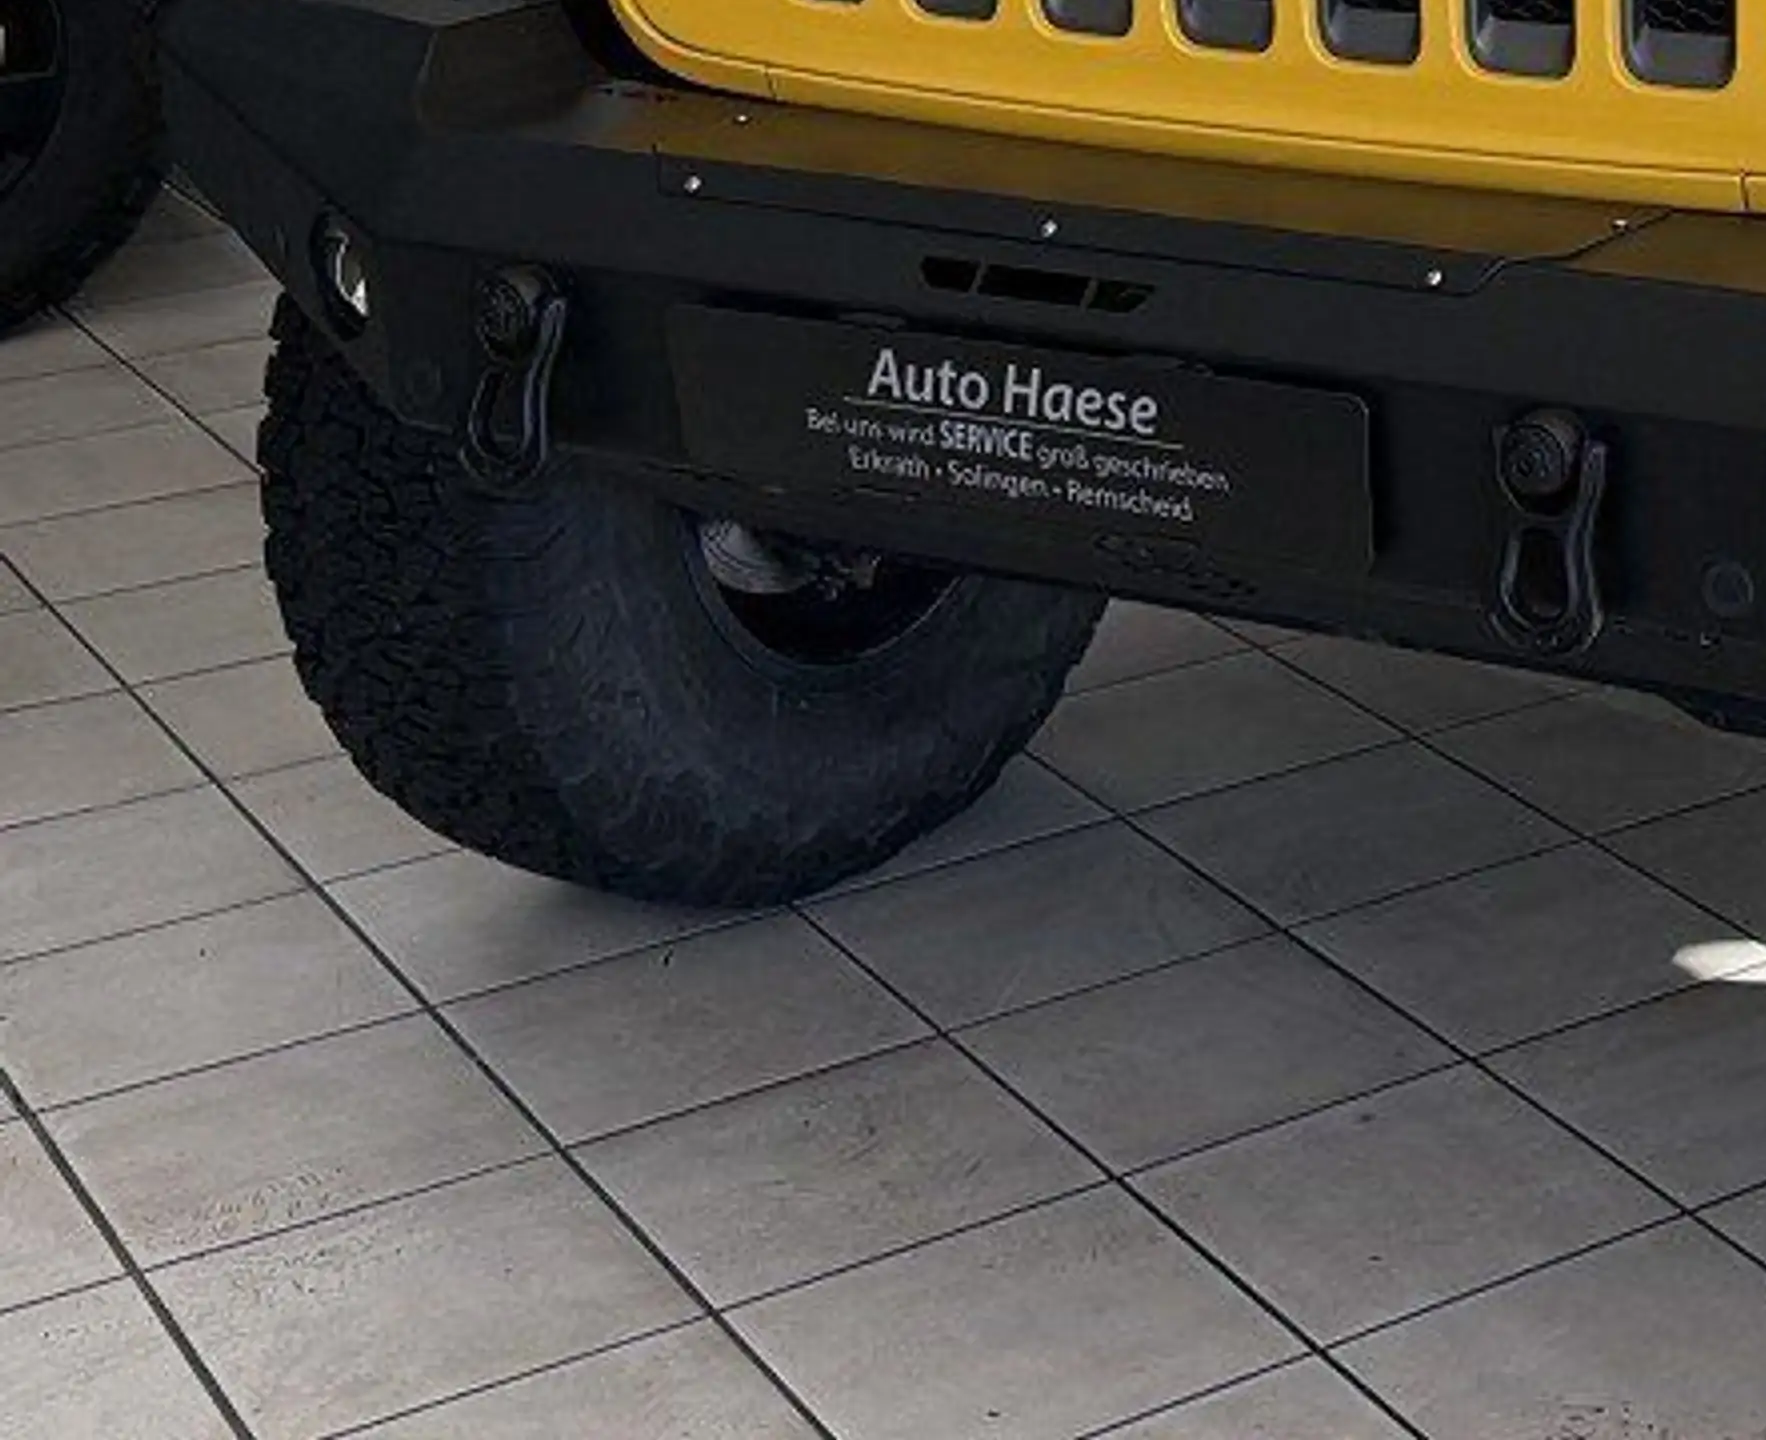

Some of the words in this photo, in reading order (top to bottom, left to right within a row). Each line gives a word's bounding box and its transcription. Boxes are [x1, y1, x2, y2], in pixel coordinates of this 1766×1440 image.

[867, 348, 989, 410] Auto
[1003, 363, 1158, 435] Haese
[848, 445, 931, 481] Erkrath
[947, 459, 1047, 498] Solingen
[1067, 478, 1195, 522] Remscheid
[885, 424, 937, 447] wird
[939, 419, 1034, 461] SERVICE
[1036, 444, 1089, 471] groß
[1093, 454, 1231, 492] geschrieben
